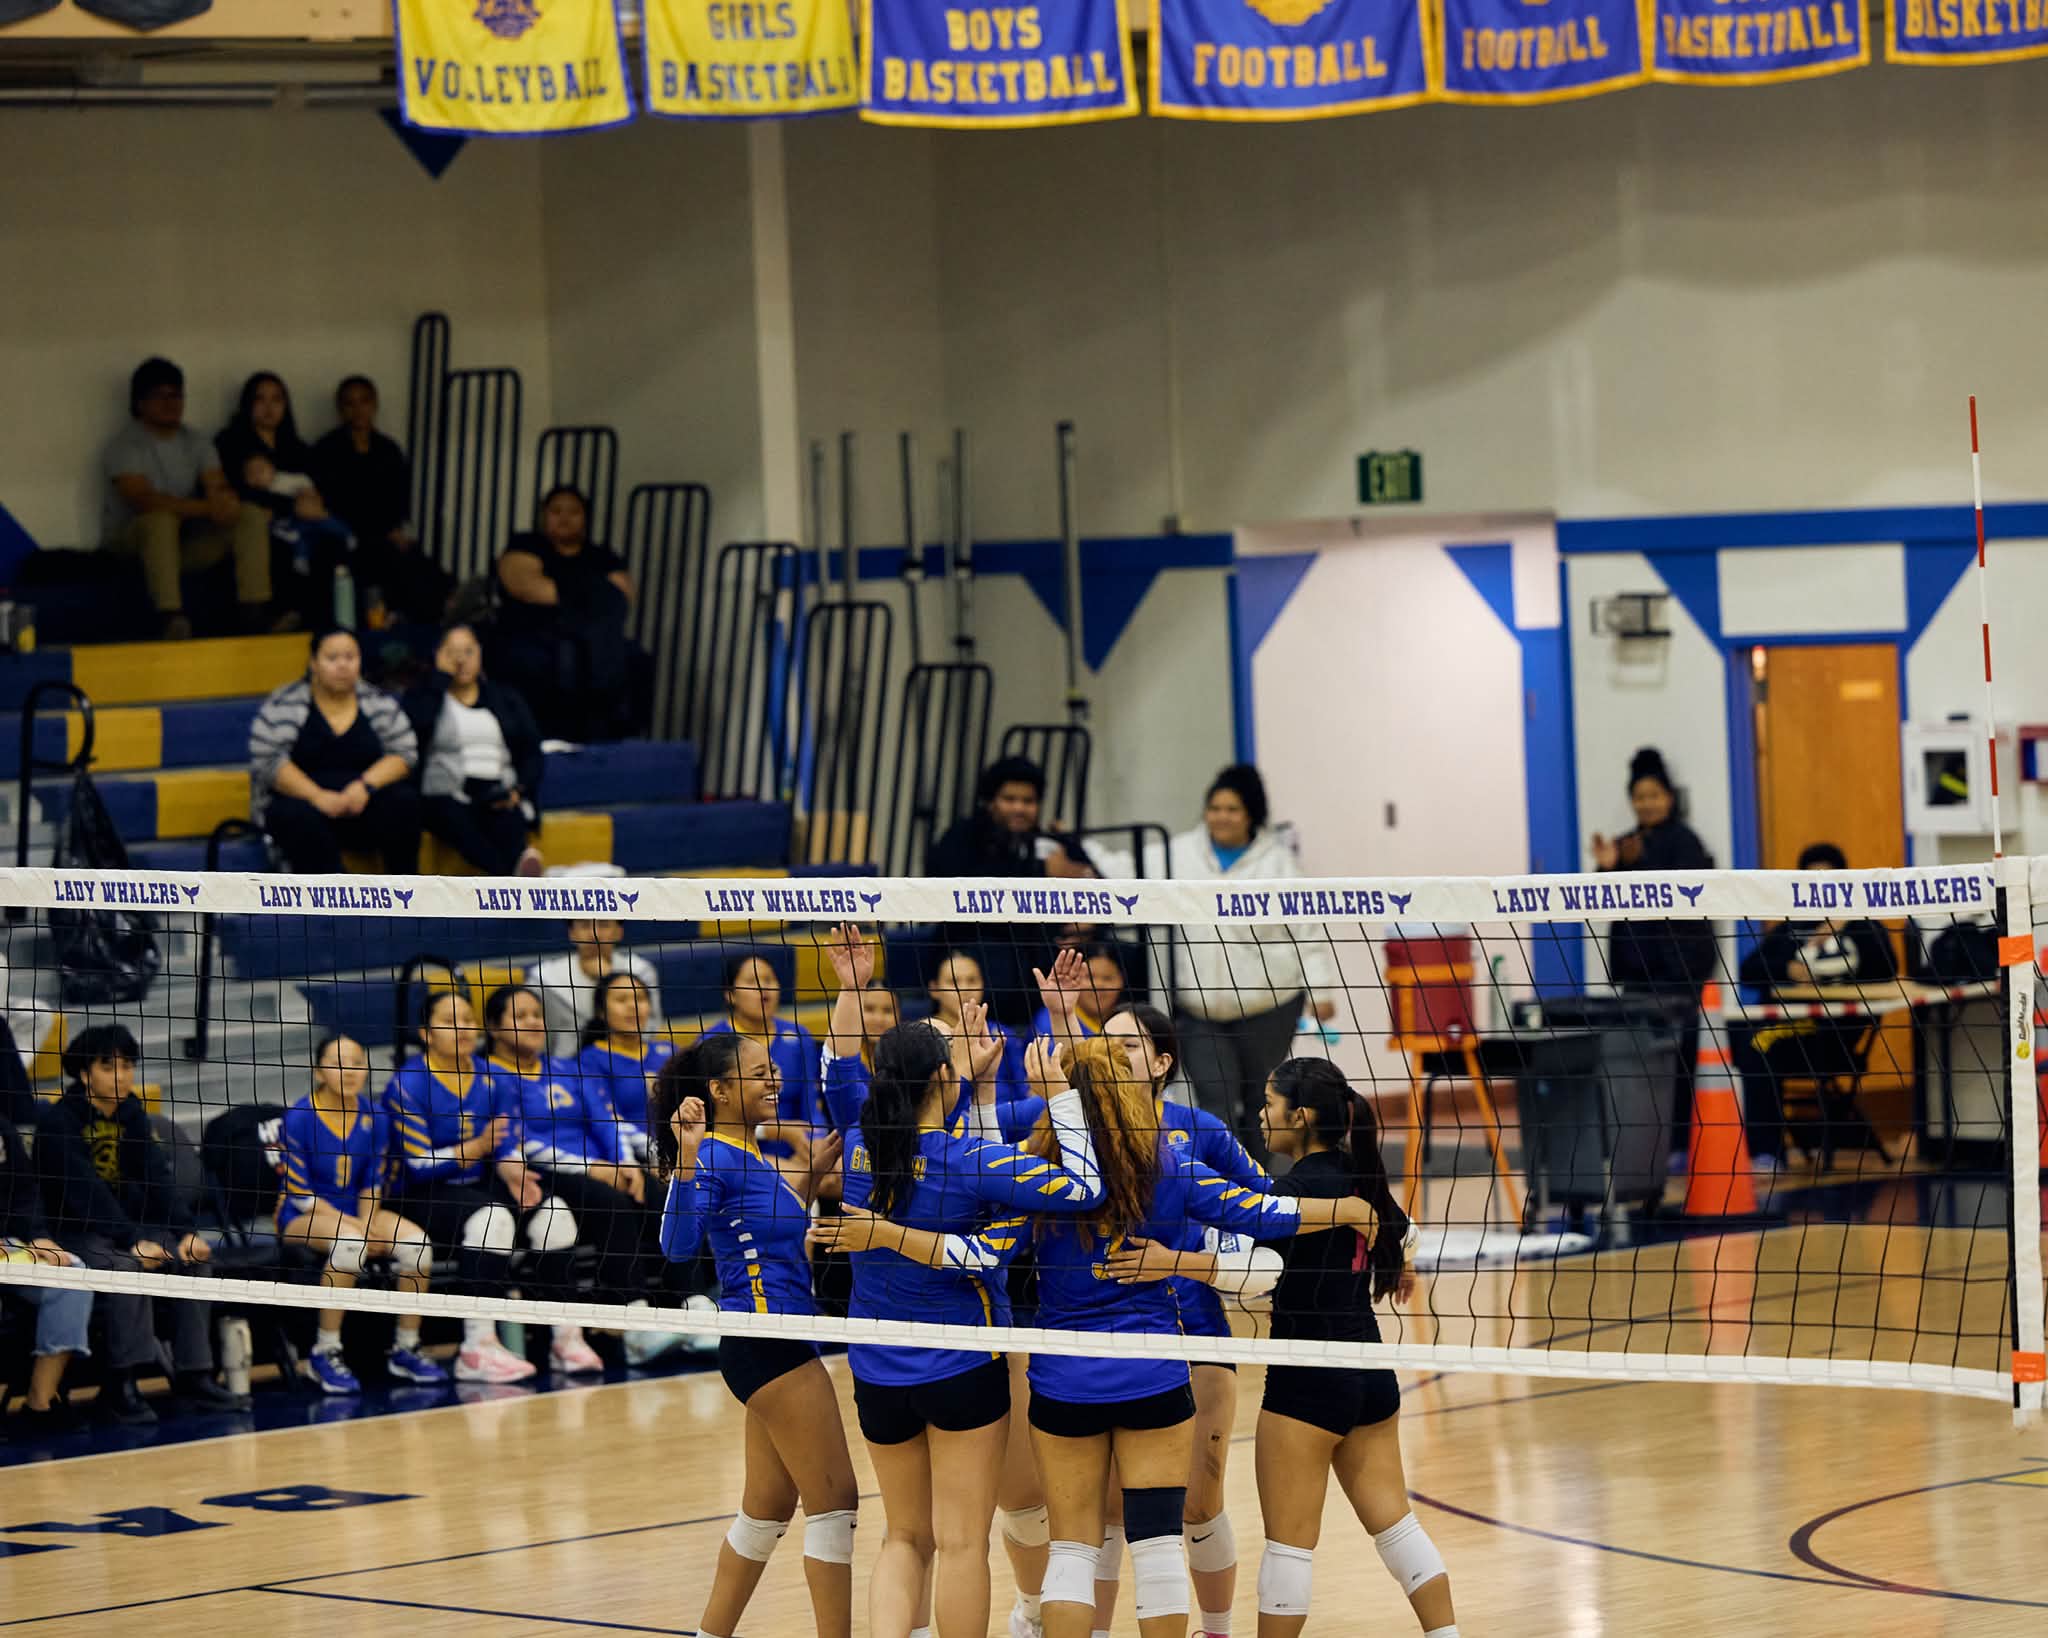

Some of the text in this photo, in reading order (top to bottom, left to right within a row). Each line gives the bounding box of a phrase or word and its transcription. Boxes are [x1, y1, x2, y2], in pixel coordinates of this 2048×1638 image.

[707, 2, 797, 40] GIRLS
[944, 6, 1042, 51] BOYS
[883, 51, 1117, 104] BASKETBALL
[1193, 37, 1388, 88] FOOTBALL
[414, 56, 608, 105] VOLEYBALL
[54, 880, 179, 904] LADY WHALERS
[259, 886, 393, 909] LADY WHALERS
[475, 888, 618, 912] LADY WHALERS
[705, 890, 857, 913] LADY WHALERS
[953, 890, 1112, 915] LADY WHALERS
[1216, 891, 1384, 917] LADY WHALERS
[1493, 883, 1673, 913] LADY WHALERS
[1791, 876, 1982, 909] LADY WHALERS
